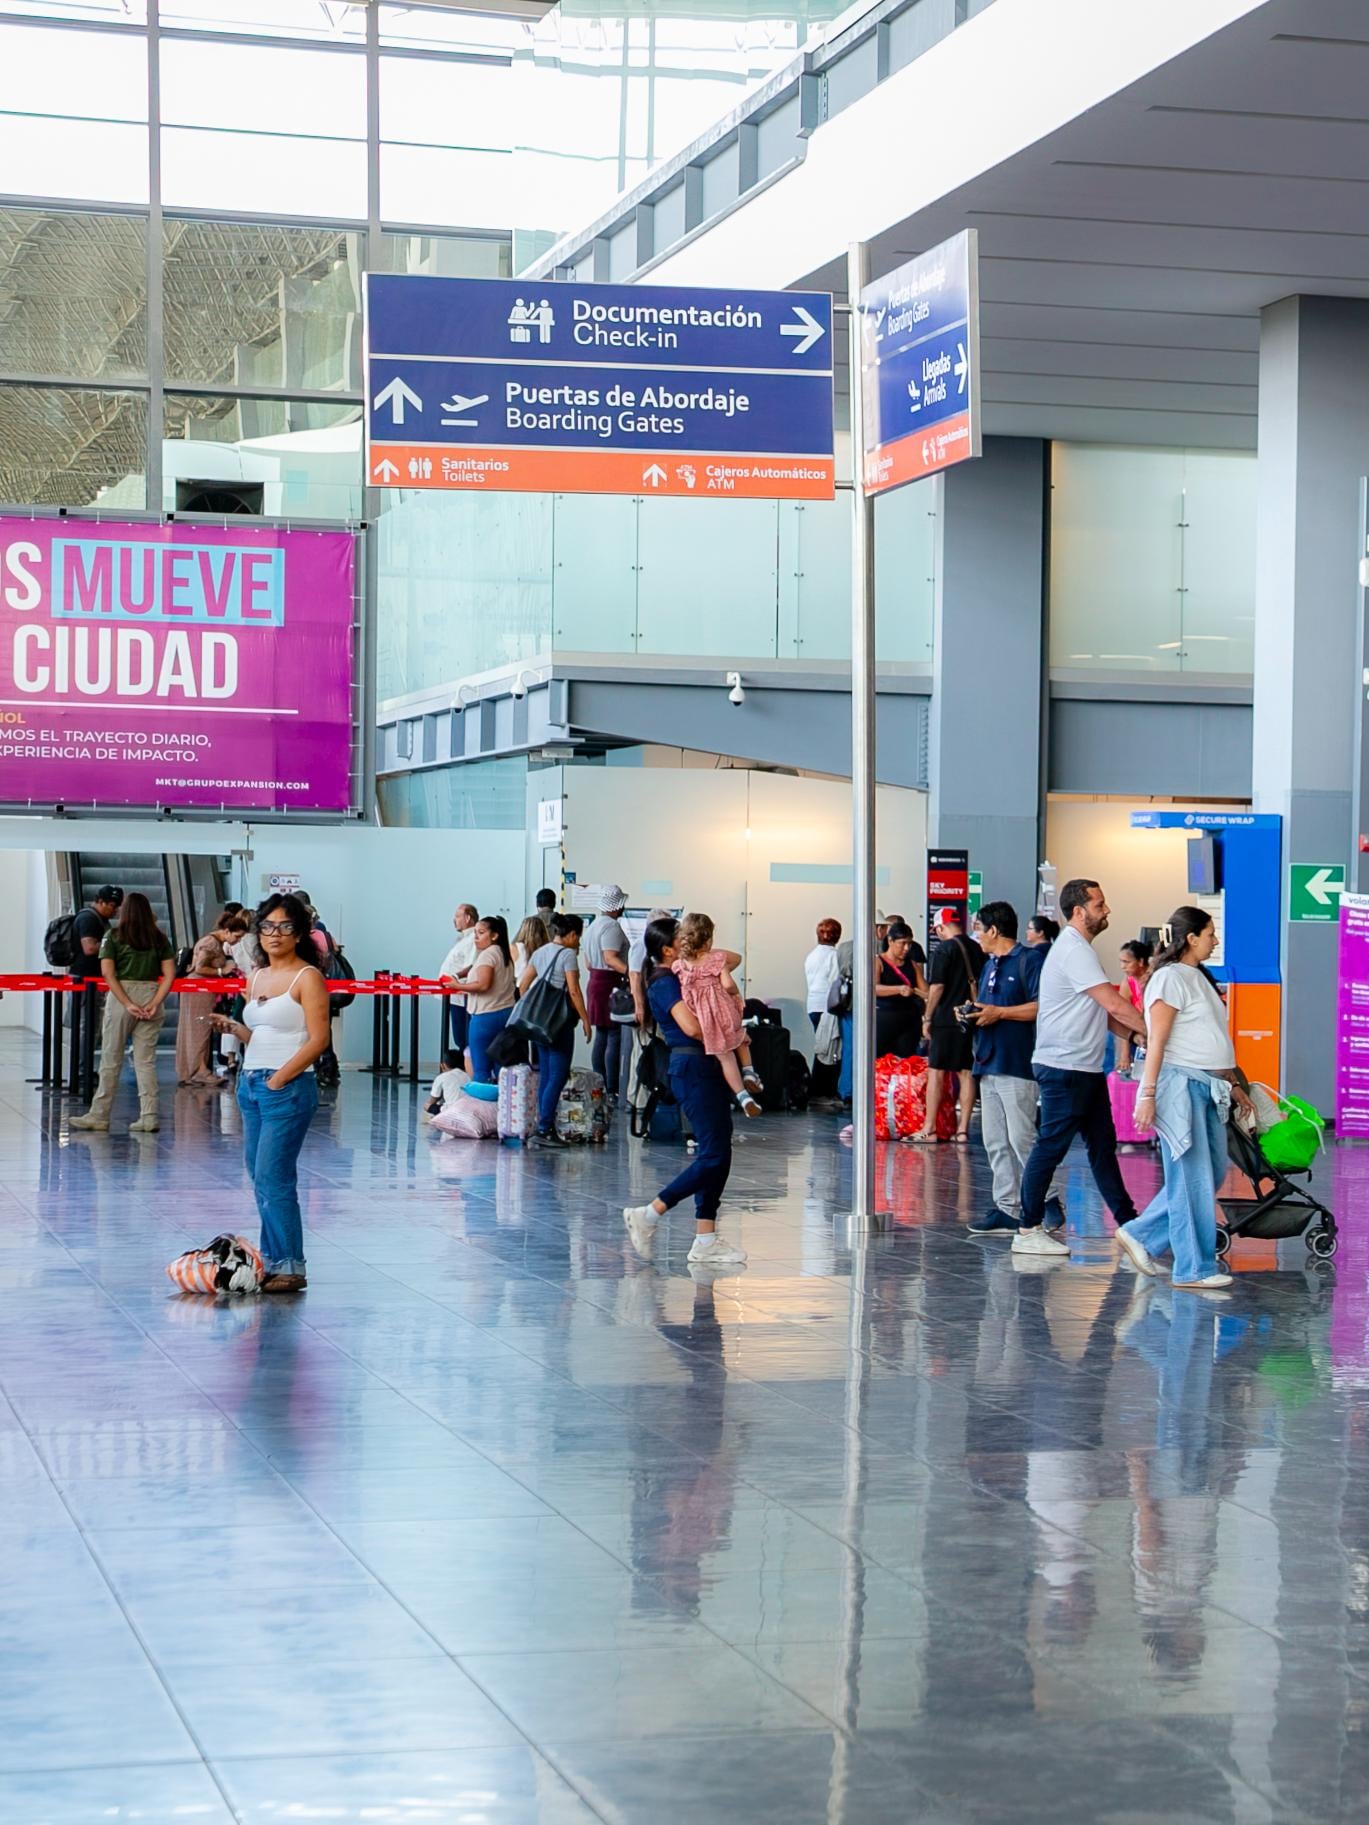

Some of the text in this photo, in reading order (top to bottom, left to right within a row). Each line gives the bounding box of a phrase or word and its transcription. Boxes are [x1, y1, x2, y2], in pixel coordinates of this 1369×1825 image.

[573, 300, 762, 328] Documentación
[888, 300, 930, 336] Boarding Gates
[573, 322, 678, 348] Check-in
[923, 352, 951, 385] Llegadas
[506, 382, 750, 417] Puertas de Abordaje
[923, 378, 946, 408] Arrivals
[506, 408, 684, 437] Boarding Gates
[441, 457, 509, 471] Sanitarios
[441, 469, 485, 482] Toilets
[706, 465, 826, 480] Cajeros Automáticos
[707, 478, 735, 490] ATM
[0, 541, 272, 620] S MUEVE
[13, 624, 239, 699] CIUDAD
[0, 729, 212, 748] MOS EL TRAYECTO DIARIO,
[0, 745, 199, 762] PERIENCIA DE IMPACTO.
[155, 777, 310, 790] MKT@GRUPOEXPANSION.COM
